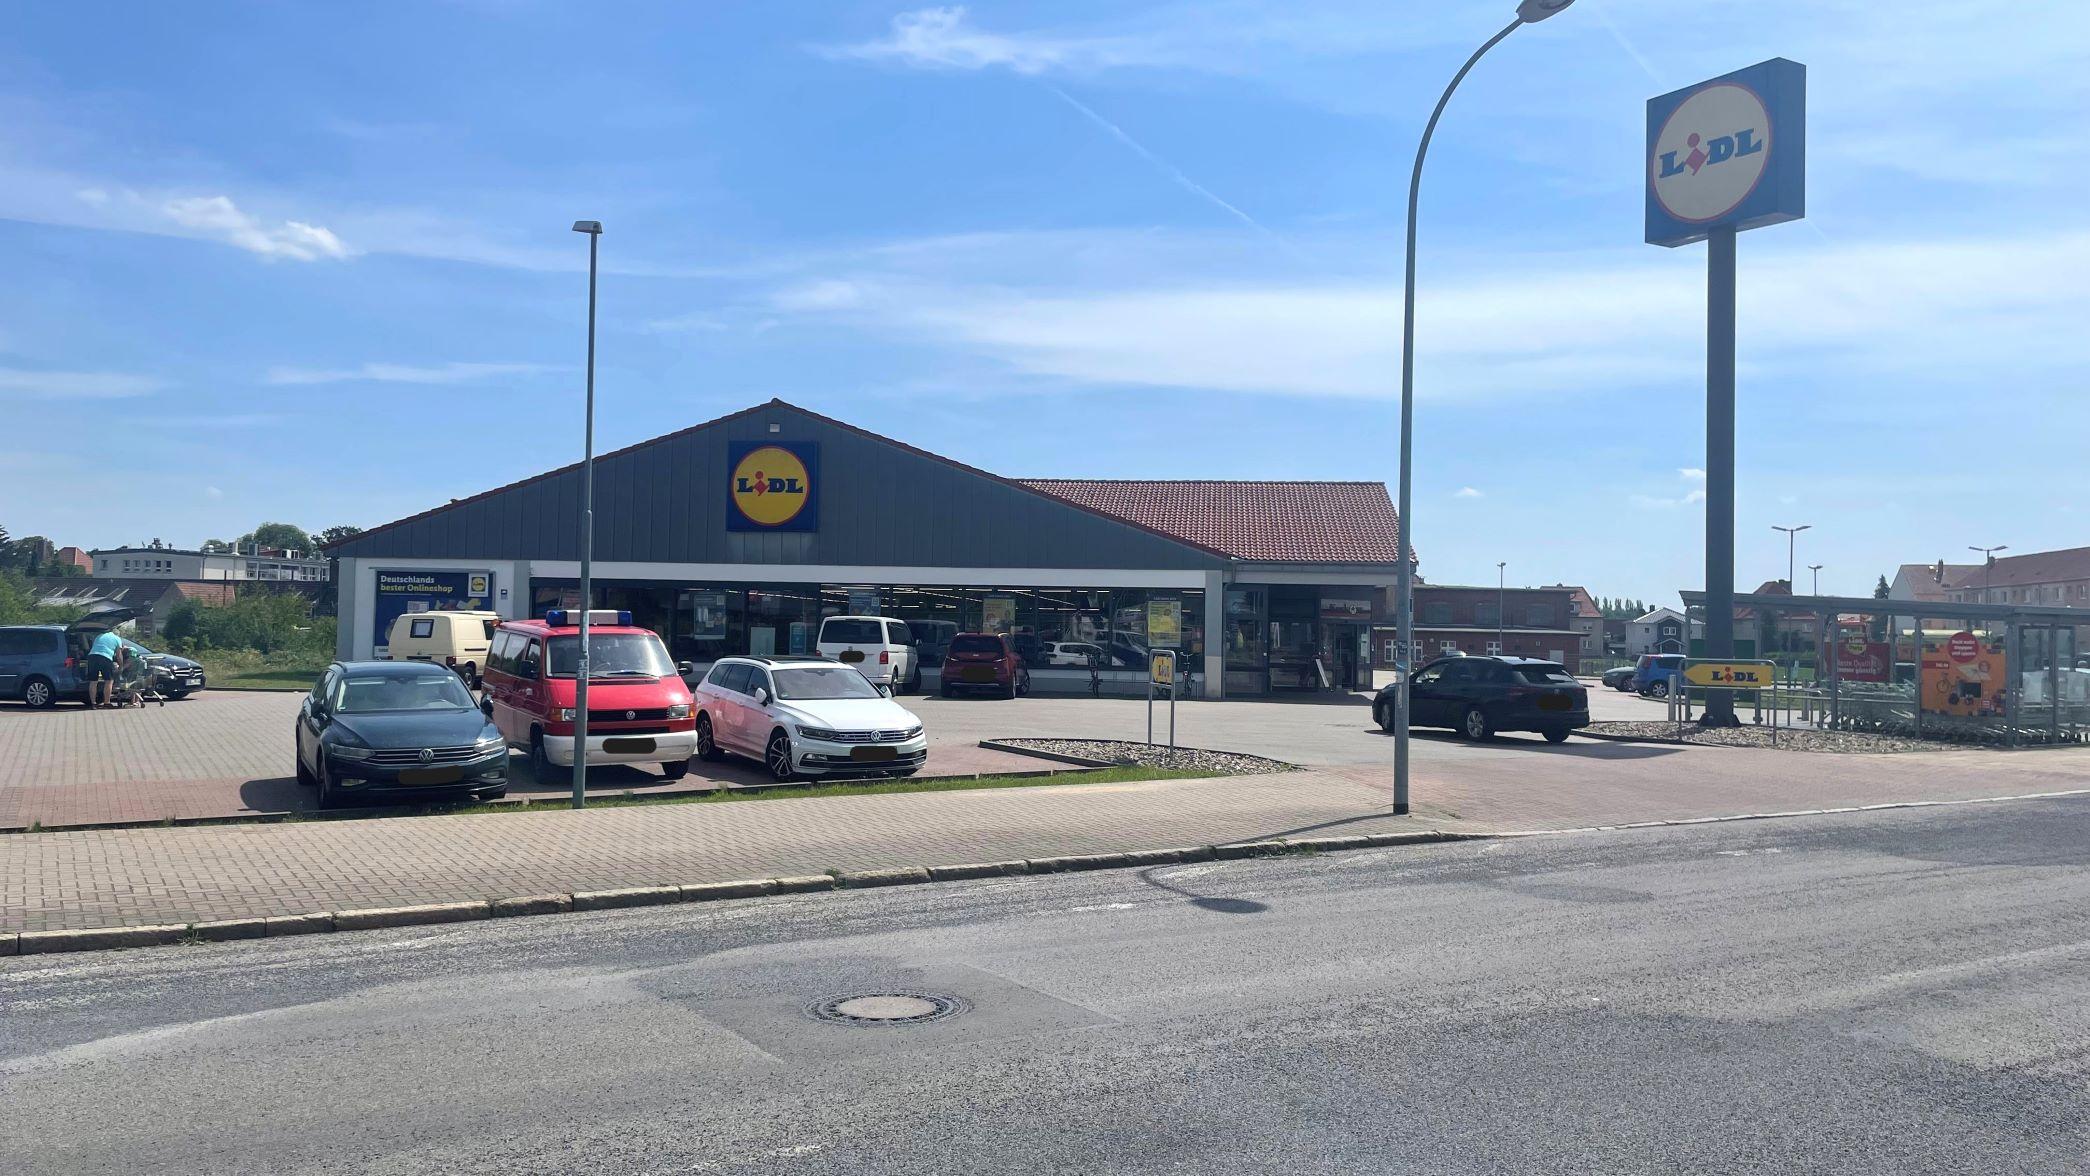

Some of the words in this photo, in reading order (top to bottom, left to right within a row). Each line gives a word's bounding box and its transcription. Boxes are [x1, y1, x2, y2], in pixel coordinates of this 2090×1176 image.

[380, 575, 434, 583] Deutschlands
[380, 583, 405, 592] bester
[407, 584, 453, 594] Onlineshop
